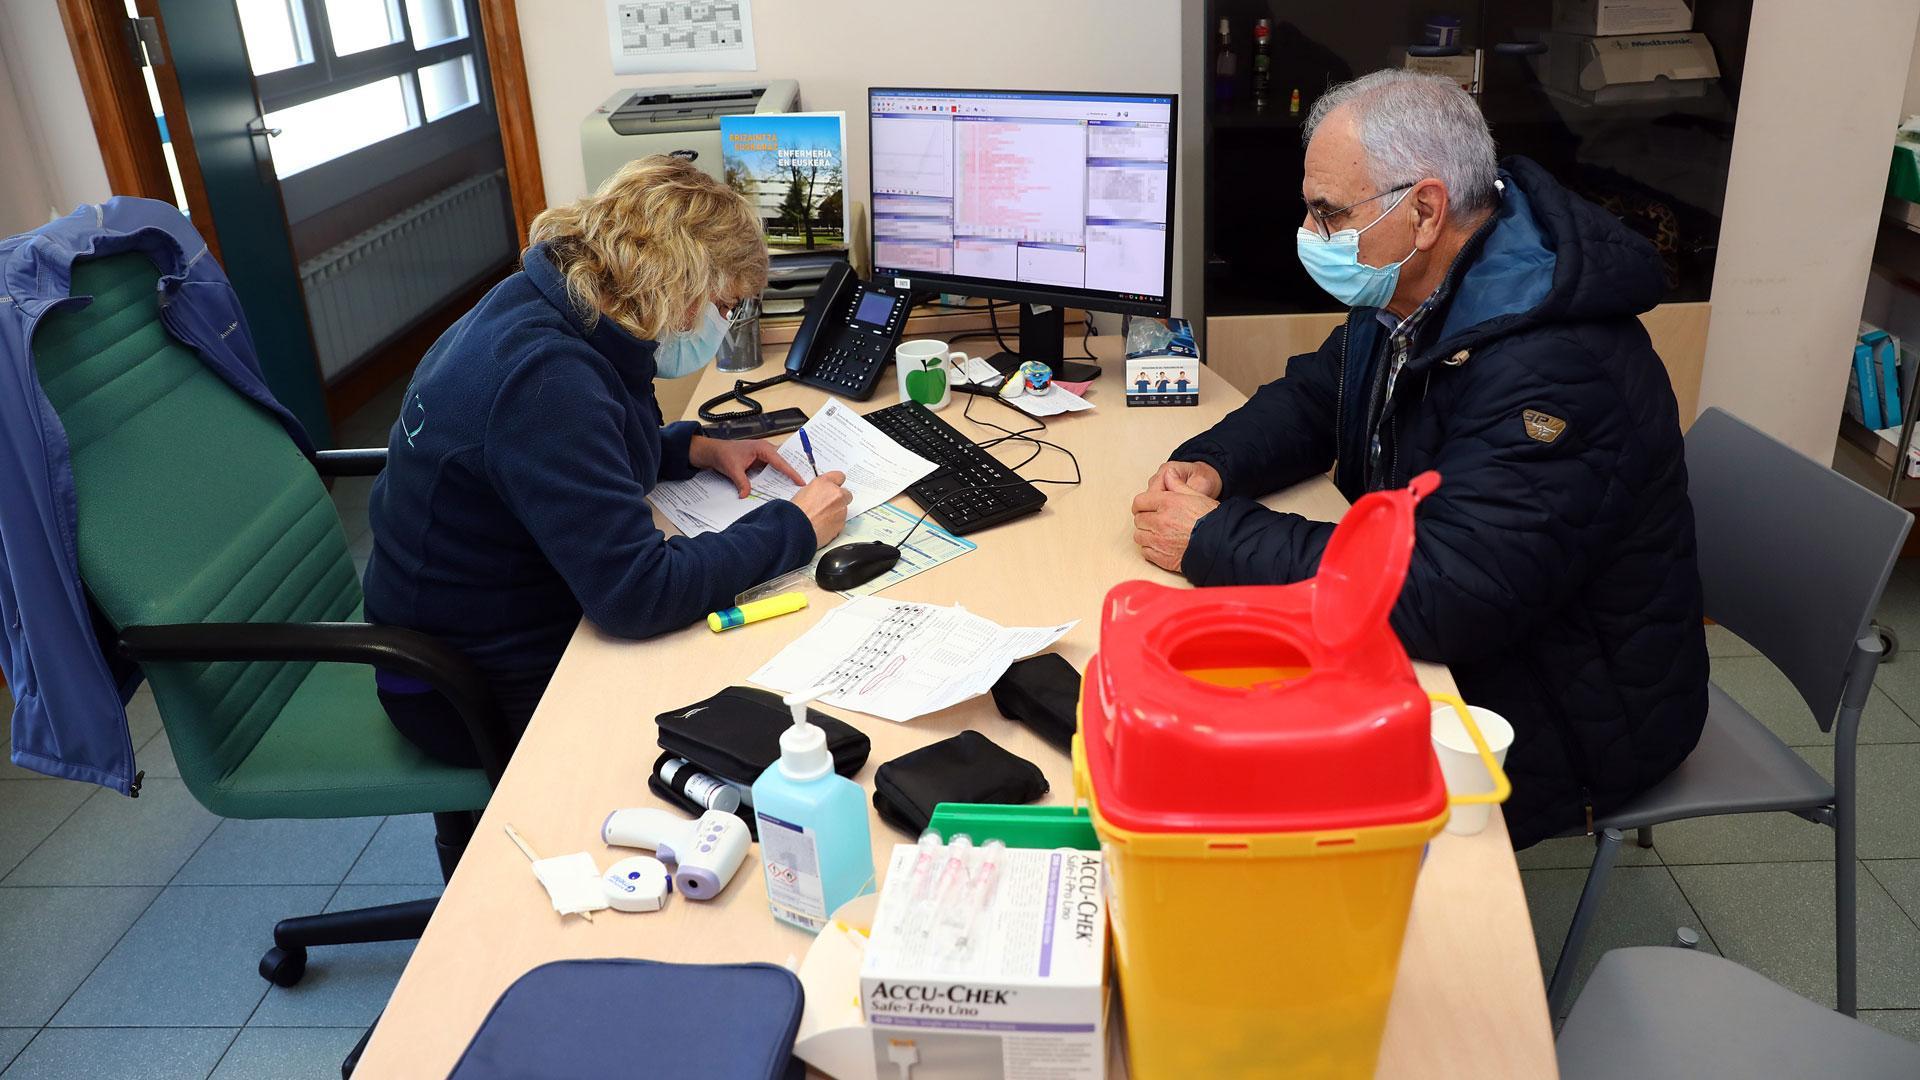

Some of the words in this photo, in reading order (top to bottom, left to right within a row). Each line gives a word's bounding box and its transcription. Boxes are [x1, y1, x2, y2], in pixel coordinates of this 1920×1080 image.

[1631, 37, 1693, 48] Medtronic
[778, 148, 832, 158] ENFERMERÍA
[778, 158, 790, 167] EN
[792, 158, 830, 167] EUSKERA
[1076, 855, 1100, 941] ACCU-CHEK
[871, 982, 1009, 1005] ACCU-CHEK
[871, 1001, 945, 1016] Safe-T-Pro
[948, 1006, 979, 1017] Uno
